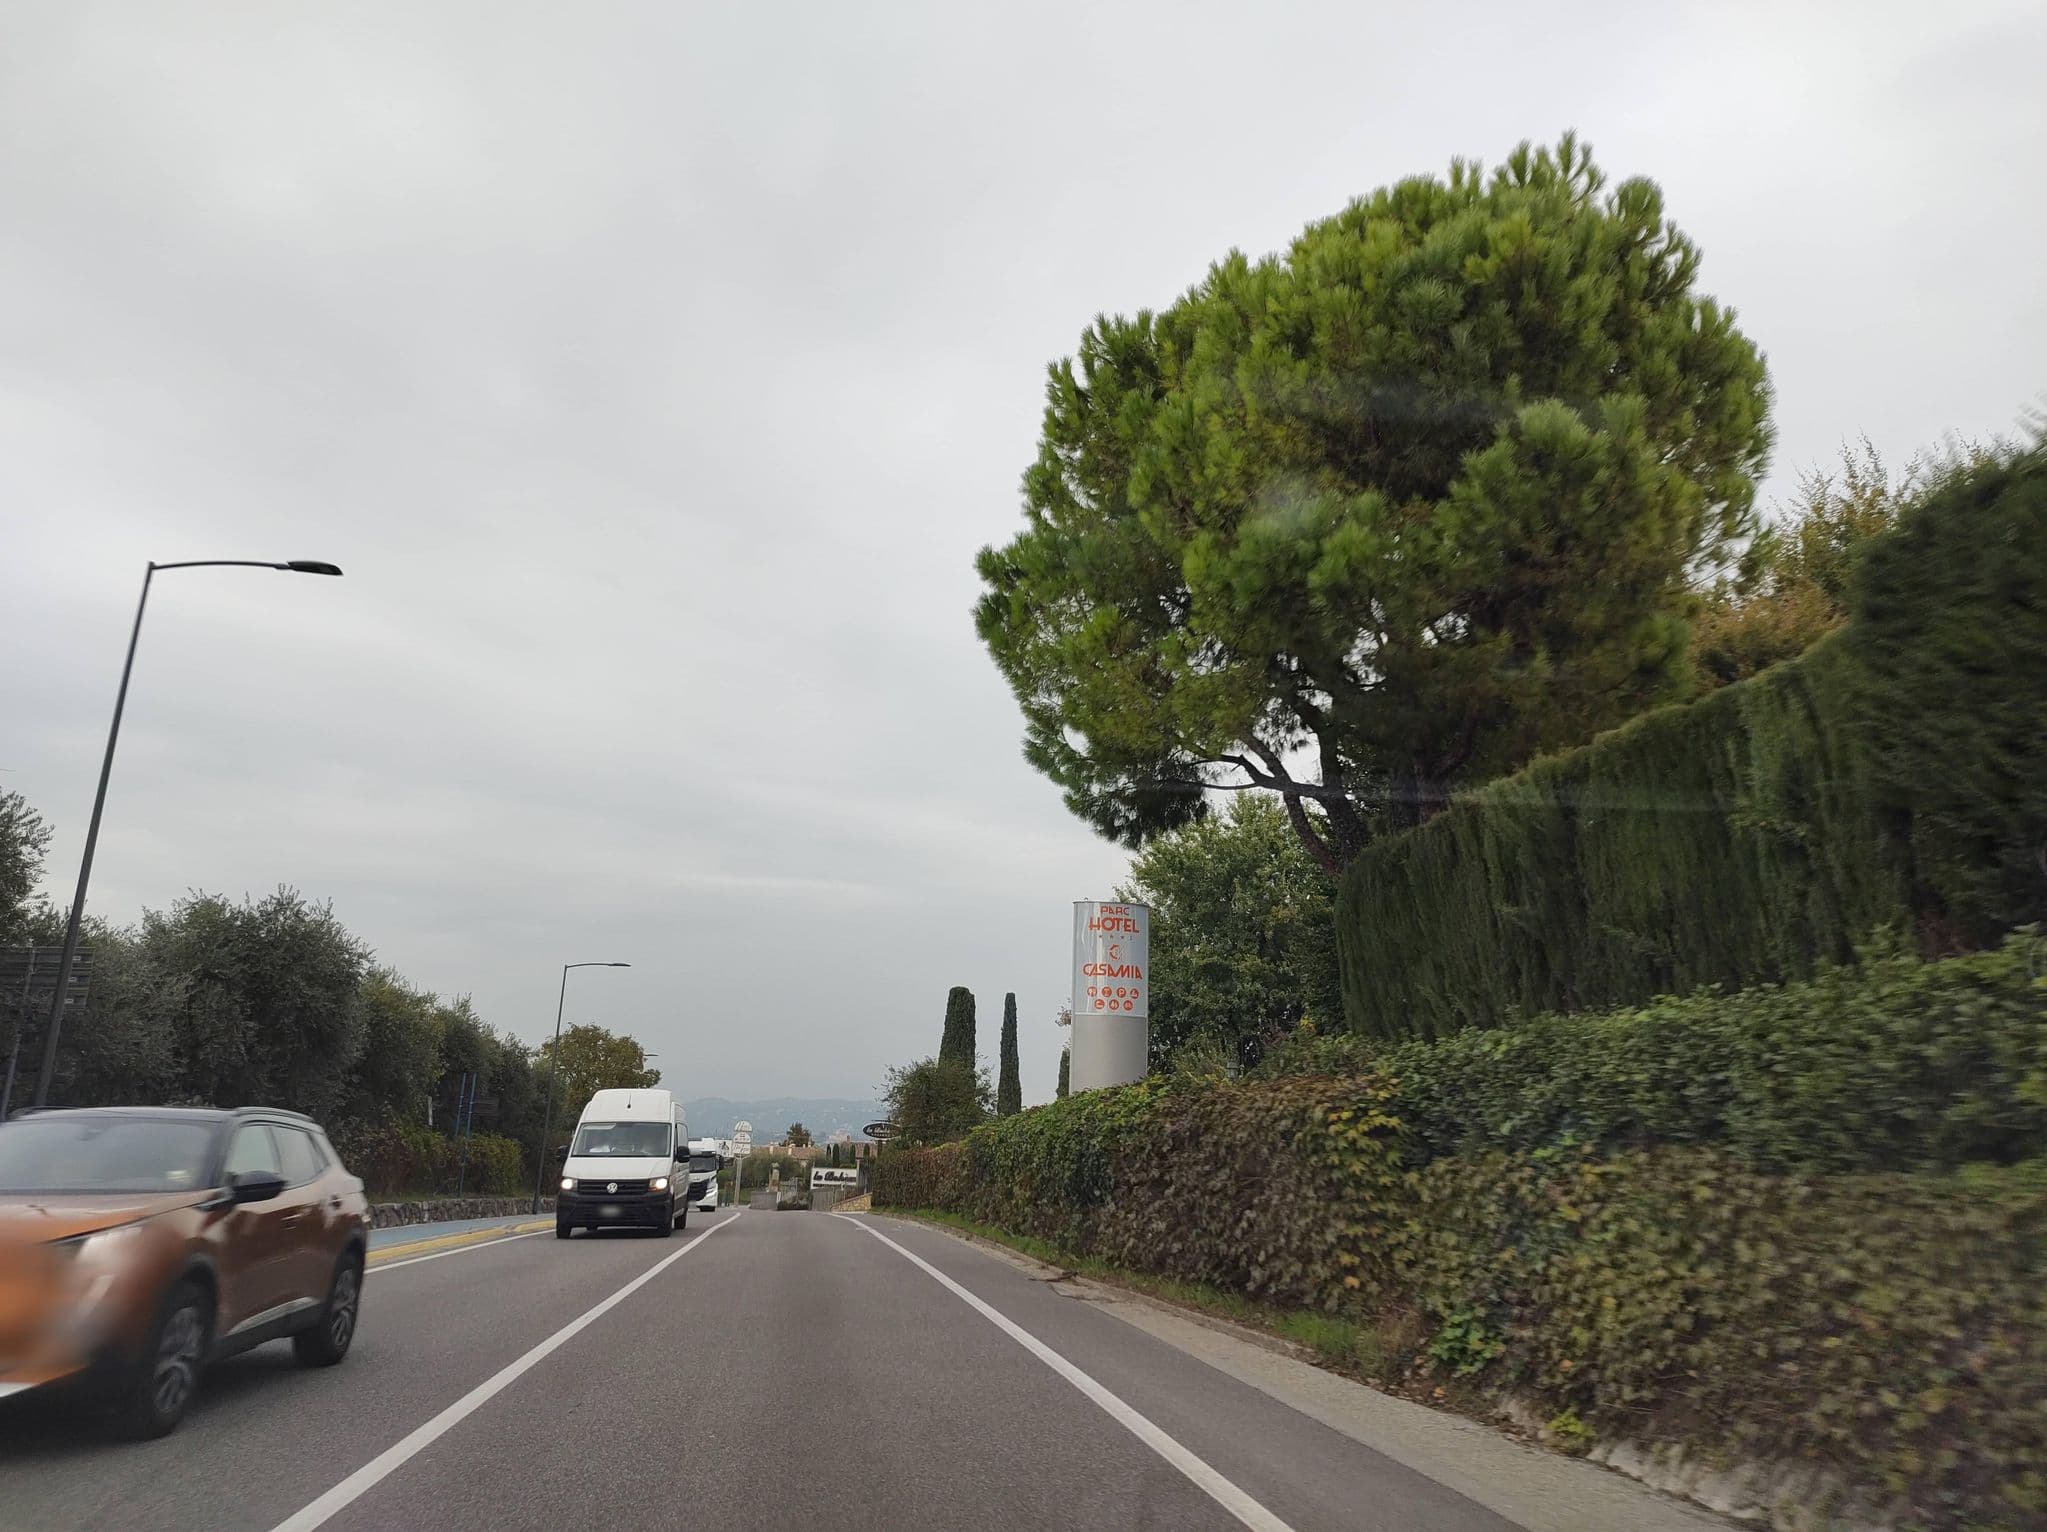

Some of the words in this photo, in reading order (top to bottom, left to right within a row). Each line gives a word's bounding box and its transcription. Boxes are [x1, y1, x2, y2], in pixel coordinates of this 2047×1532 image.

[1100, 905, 1130, 916] PARC
[1089, 917, 1140, 933] HOTEL
[1083, 963, 1143, 980] CASAMIA
